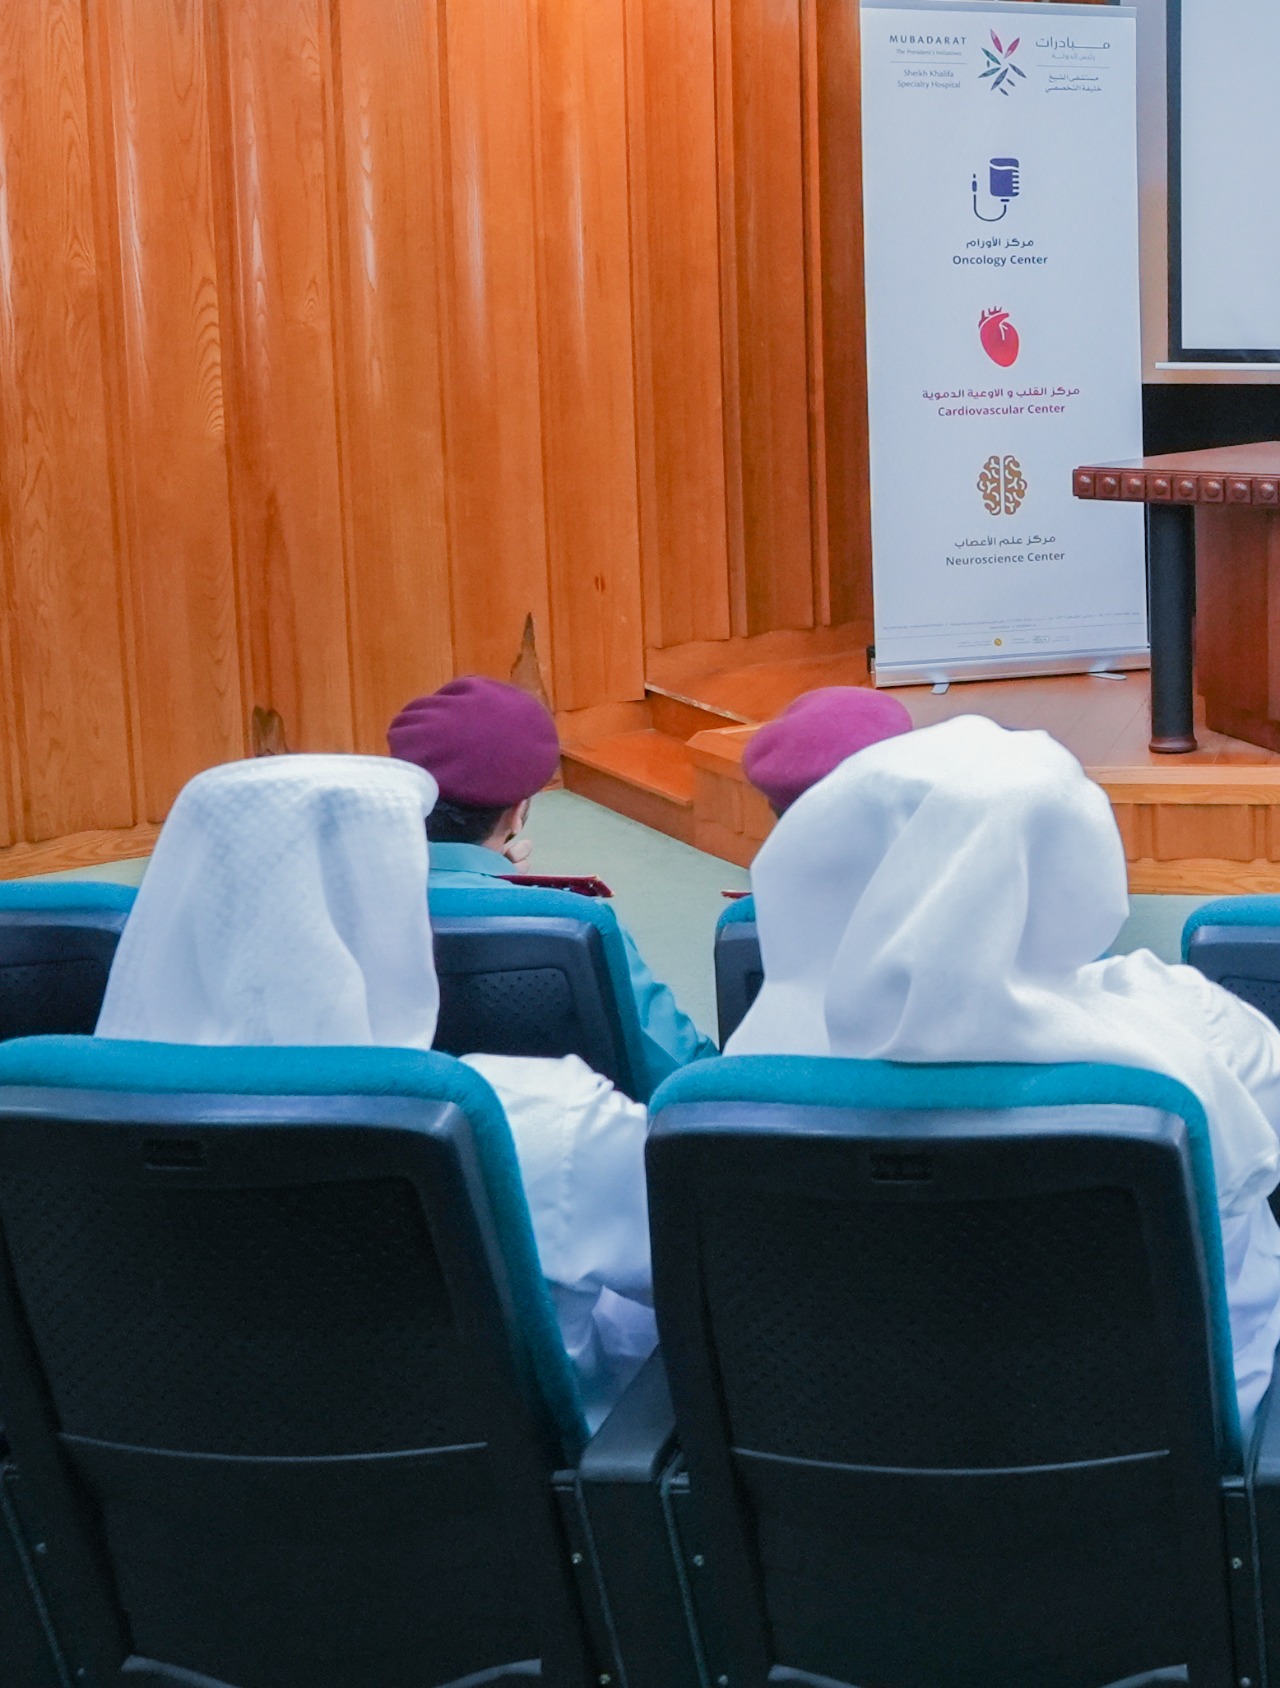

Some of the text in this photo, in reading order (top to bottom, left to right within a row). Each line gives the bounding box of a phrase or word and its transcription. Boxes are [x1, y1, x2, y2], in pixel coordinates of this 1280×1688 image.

[888, 35, 967, 45] MUBADARAT
[1035, 36, 1110, 50] مبادرات
[903, 69, 954, 78] Sheikh Khalifa
[897, 80, 961, 89] Specialty Hospital
[966, 236, 1034, 249] مركز الأورام
[952, 255, 1048, 267] Oncology Center
[922, 389, 964, 400] الدموية
[1016, 386, 1047, 397] القلب
[1050, 386, 1080, 397] مركز
[938, 404, 1066, 416] Cardiovascular Center
[954, 535, 1056, 549] مركز علم الأعصاب
[946, 552, 1065, 566] Neuroscience Center
